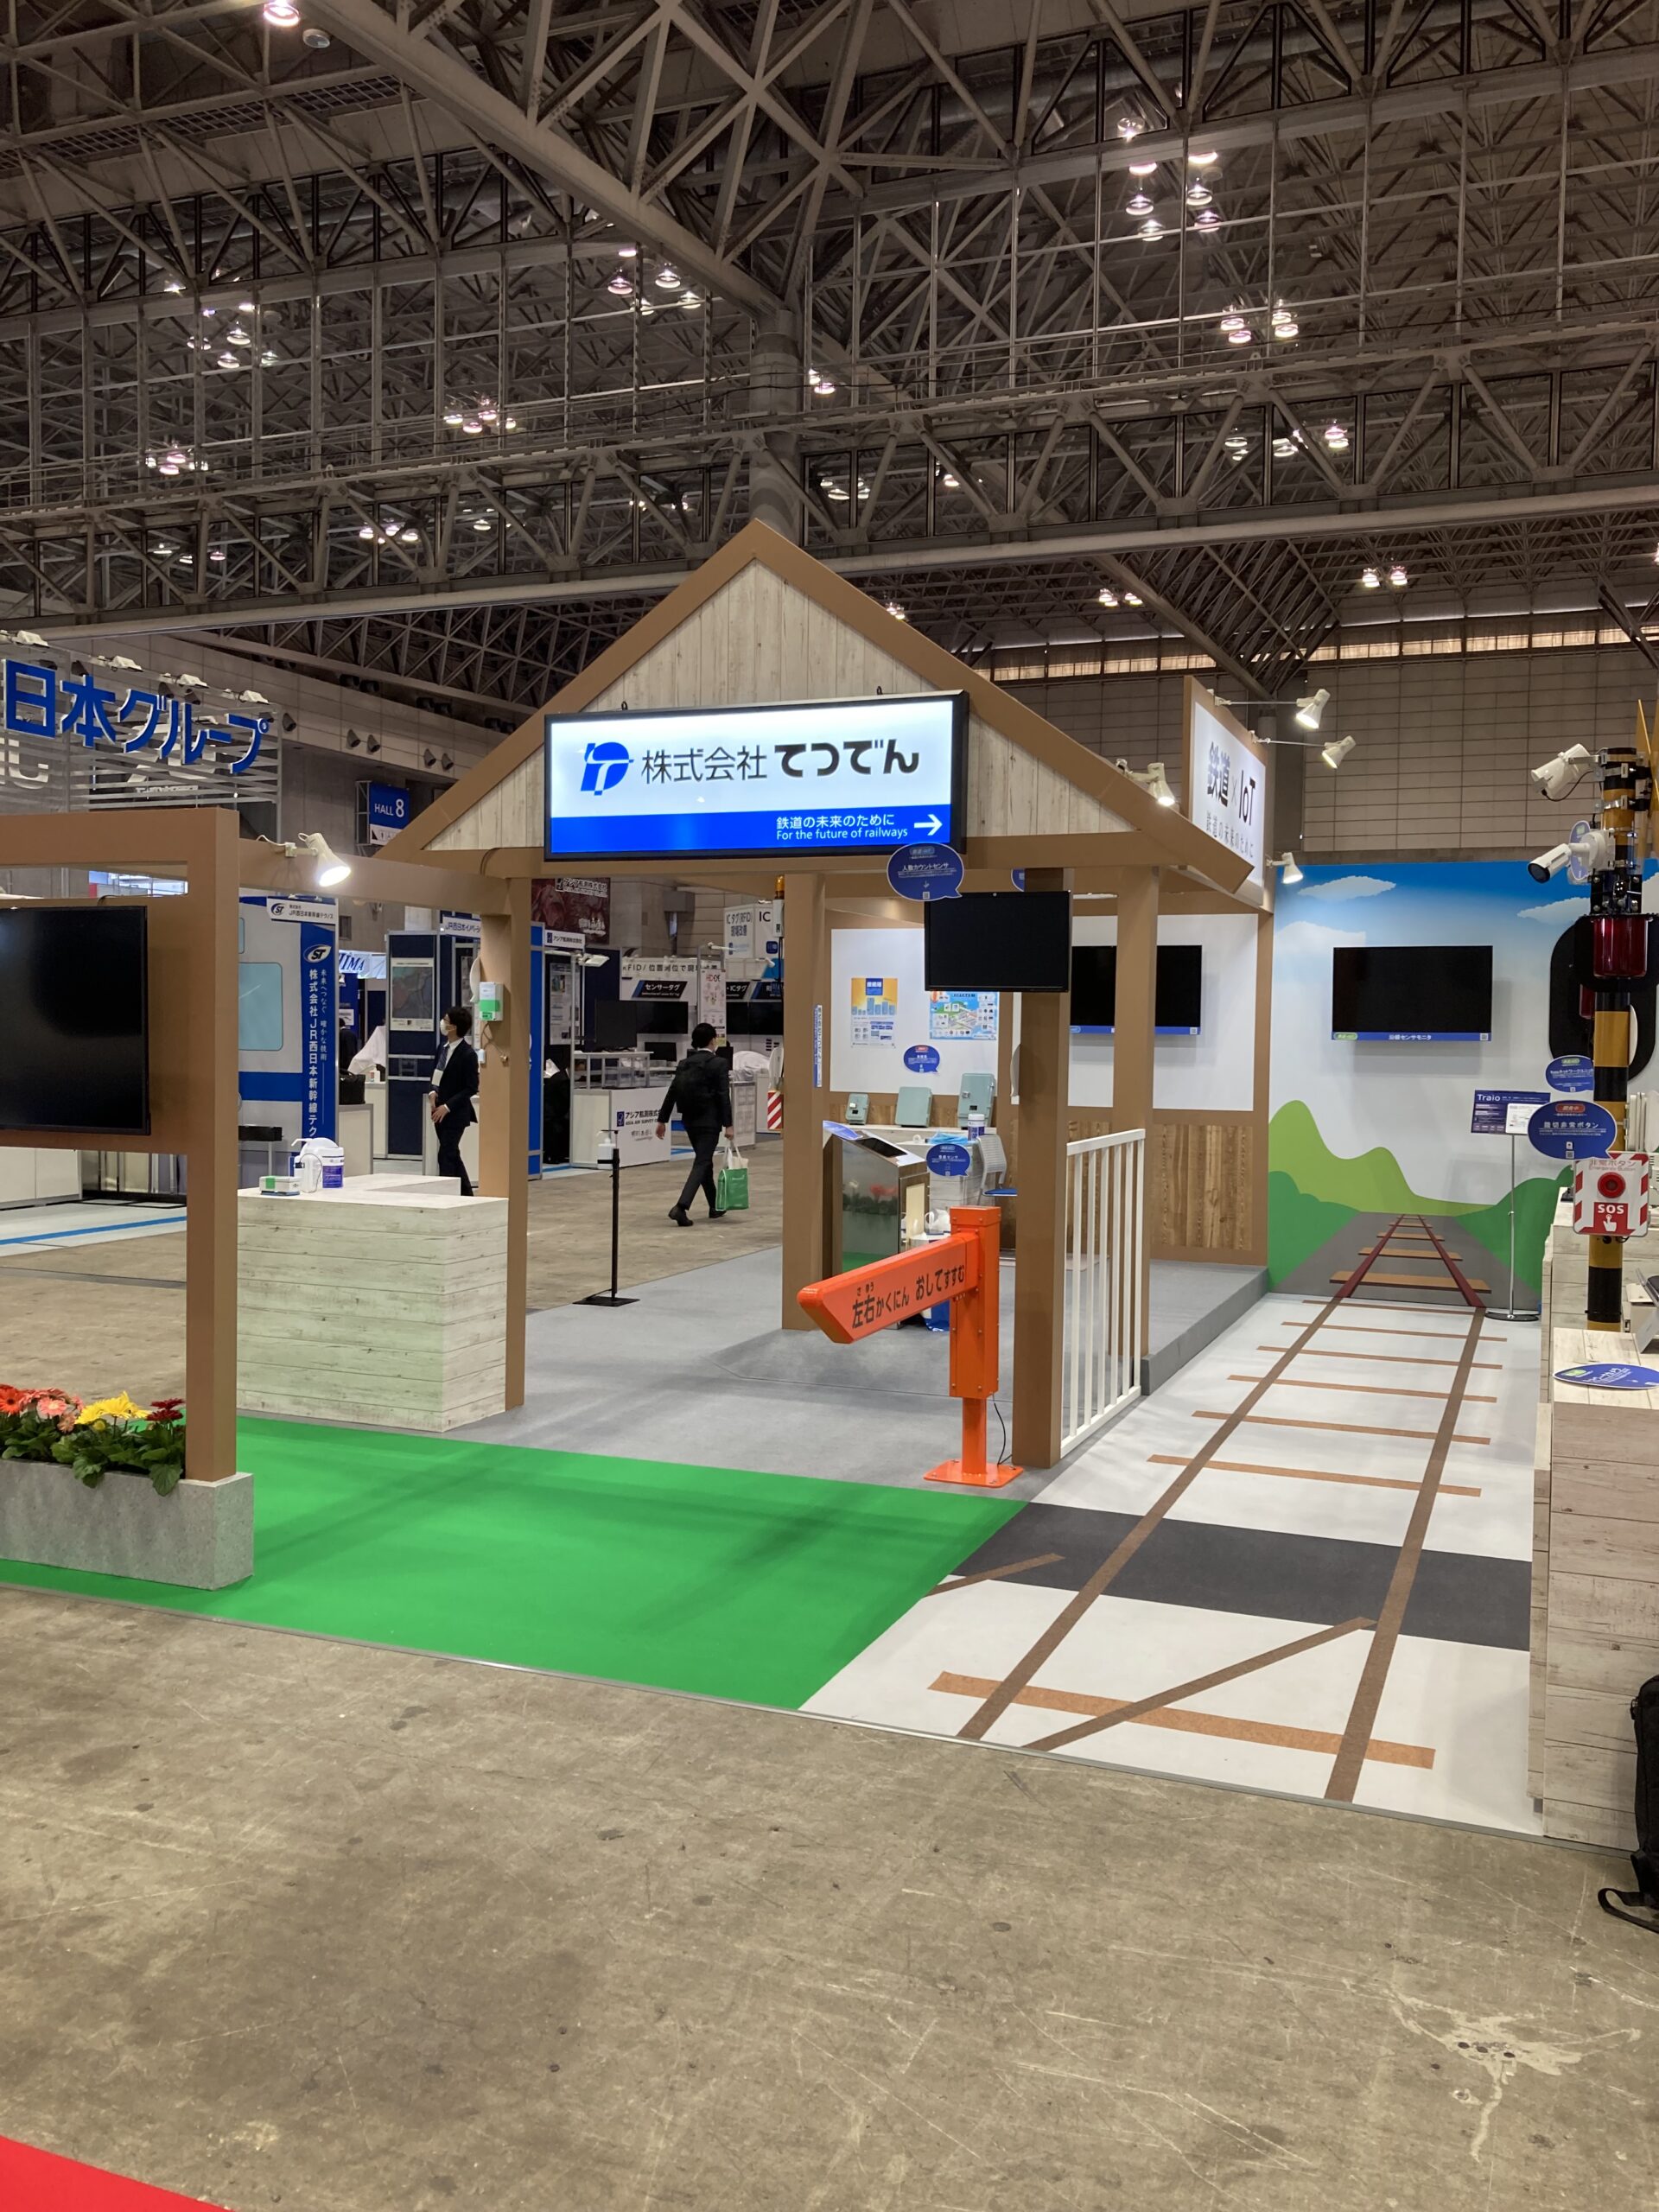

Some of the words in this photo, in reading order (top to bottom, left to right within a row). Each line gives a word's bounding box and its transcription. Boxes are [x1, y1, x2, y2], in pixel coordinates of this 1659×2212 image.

[3, 658, 270, 774] 日本グループ
[641, 744, 768, 785] 株式会社
[774, 739, 920, 777] てつでん
[374, 803, 394, 817] HALL
[395, 798, 404, 817] 8
[776, 814, 894, 830] 鉄道の未来のために
[776, 830, 793, 840] For
[795, 830, 813, 840] the
[815, 828, 848, 840] future
[850, 827, 862, 838] of
[864, 826, 908, 840] railways
[1476, 1093, 1501, 1102] Traio
[1598, 1204, 1624, 1214] SOS
[852, 1287, 910, 1330] 左右かくにん
[915, 1264, 965, 1300] おしてすすむ
